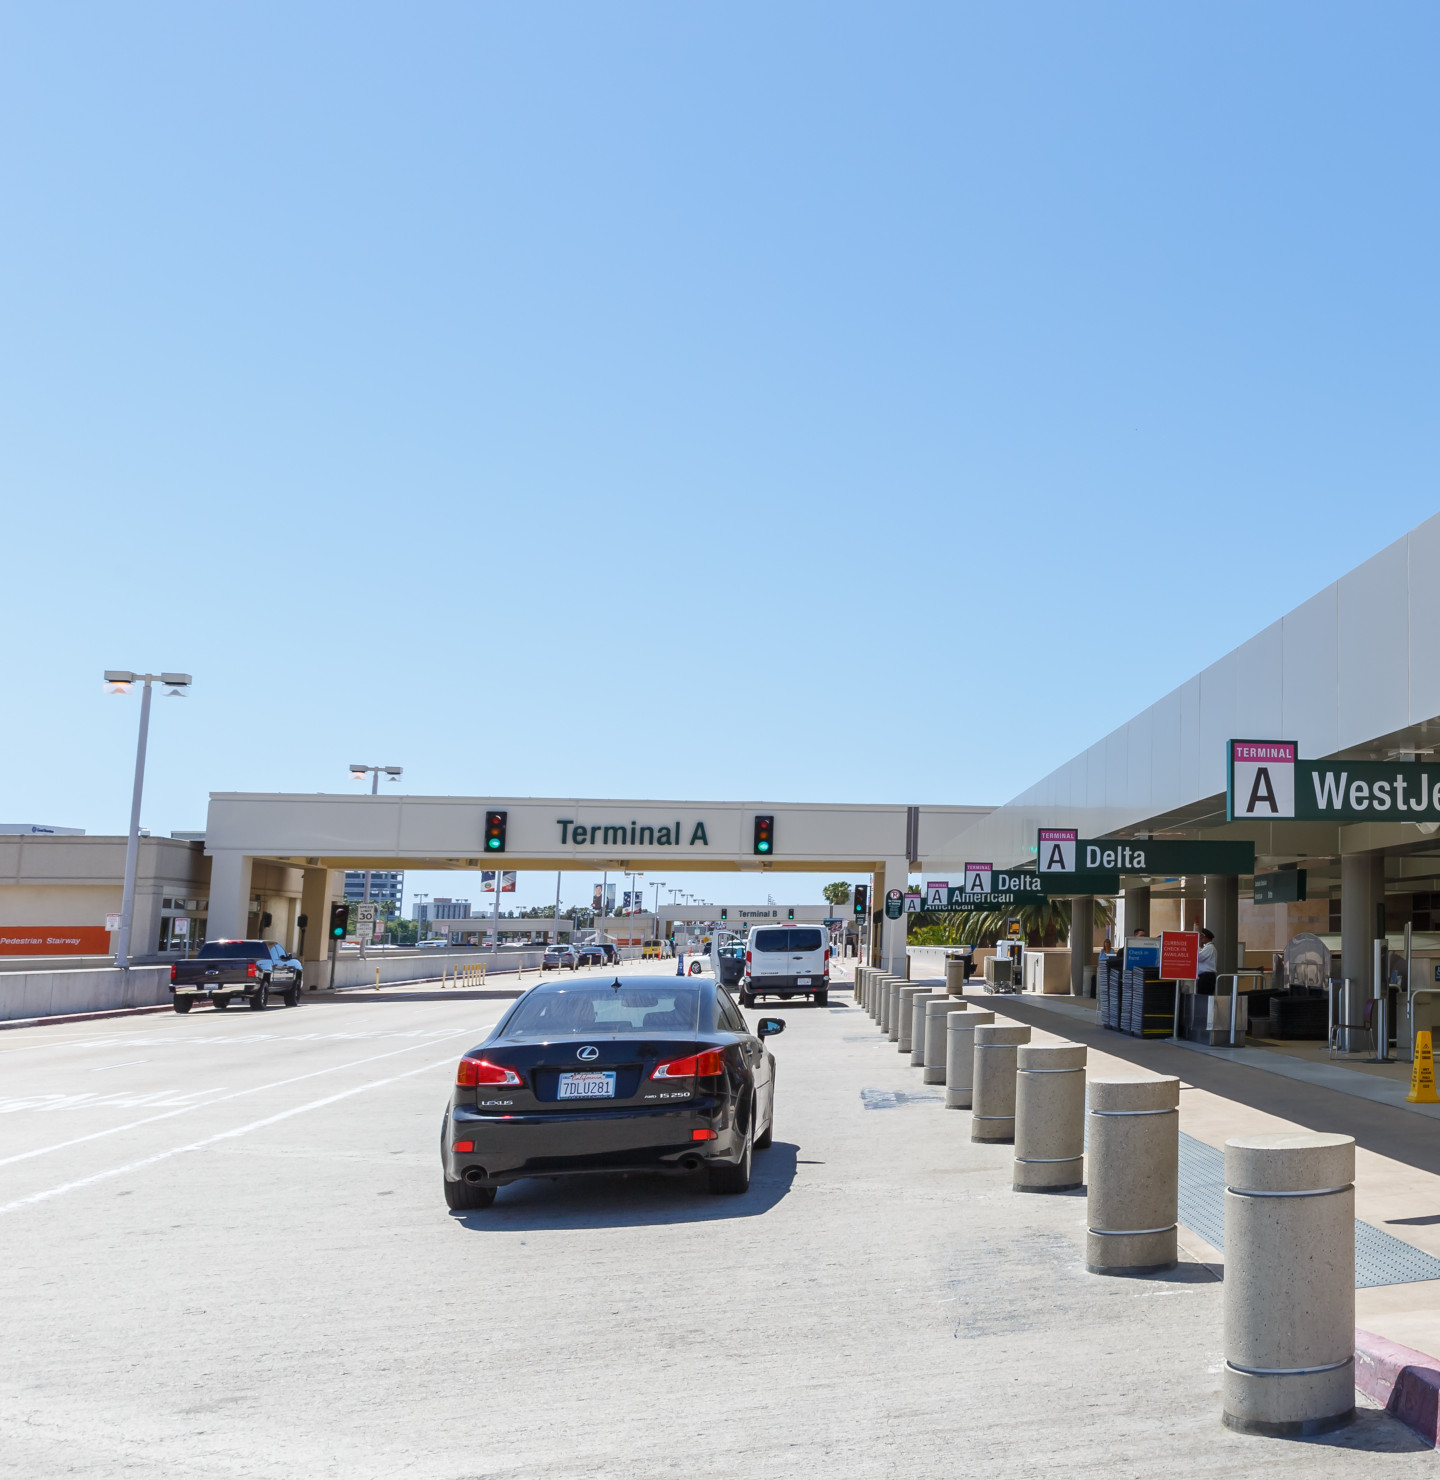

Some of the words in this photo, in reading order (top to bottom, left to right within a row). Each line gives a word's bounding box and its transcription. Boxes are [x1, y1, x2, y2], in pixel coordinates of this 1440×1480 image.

[1237, 748, 1291, 759] TERMINAL
[1246, 767, 1279, 813] A
[557, 820, 680, 846] Terminal
[690, 822, 708, 846] A
[1047, 844, 1066, 870] A
[1086, 846, 1146, 868] Delta
[970, 873, 984, 891] A
[998, 874, 1041, 890] Delta
[932, 890, 942, 903] A
[952, 890, 1014, 903] American
[908, 900, 916, 911] A
[563, 1081, 610, 1095] 7DLU281
